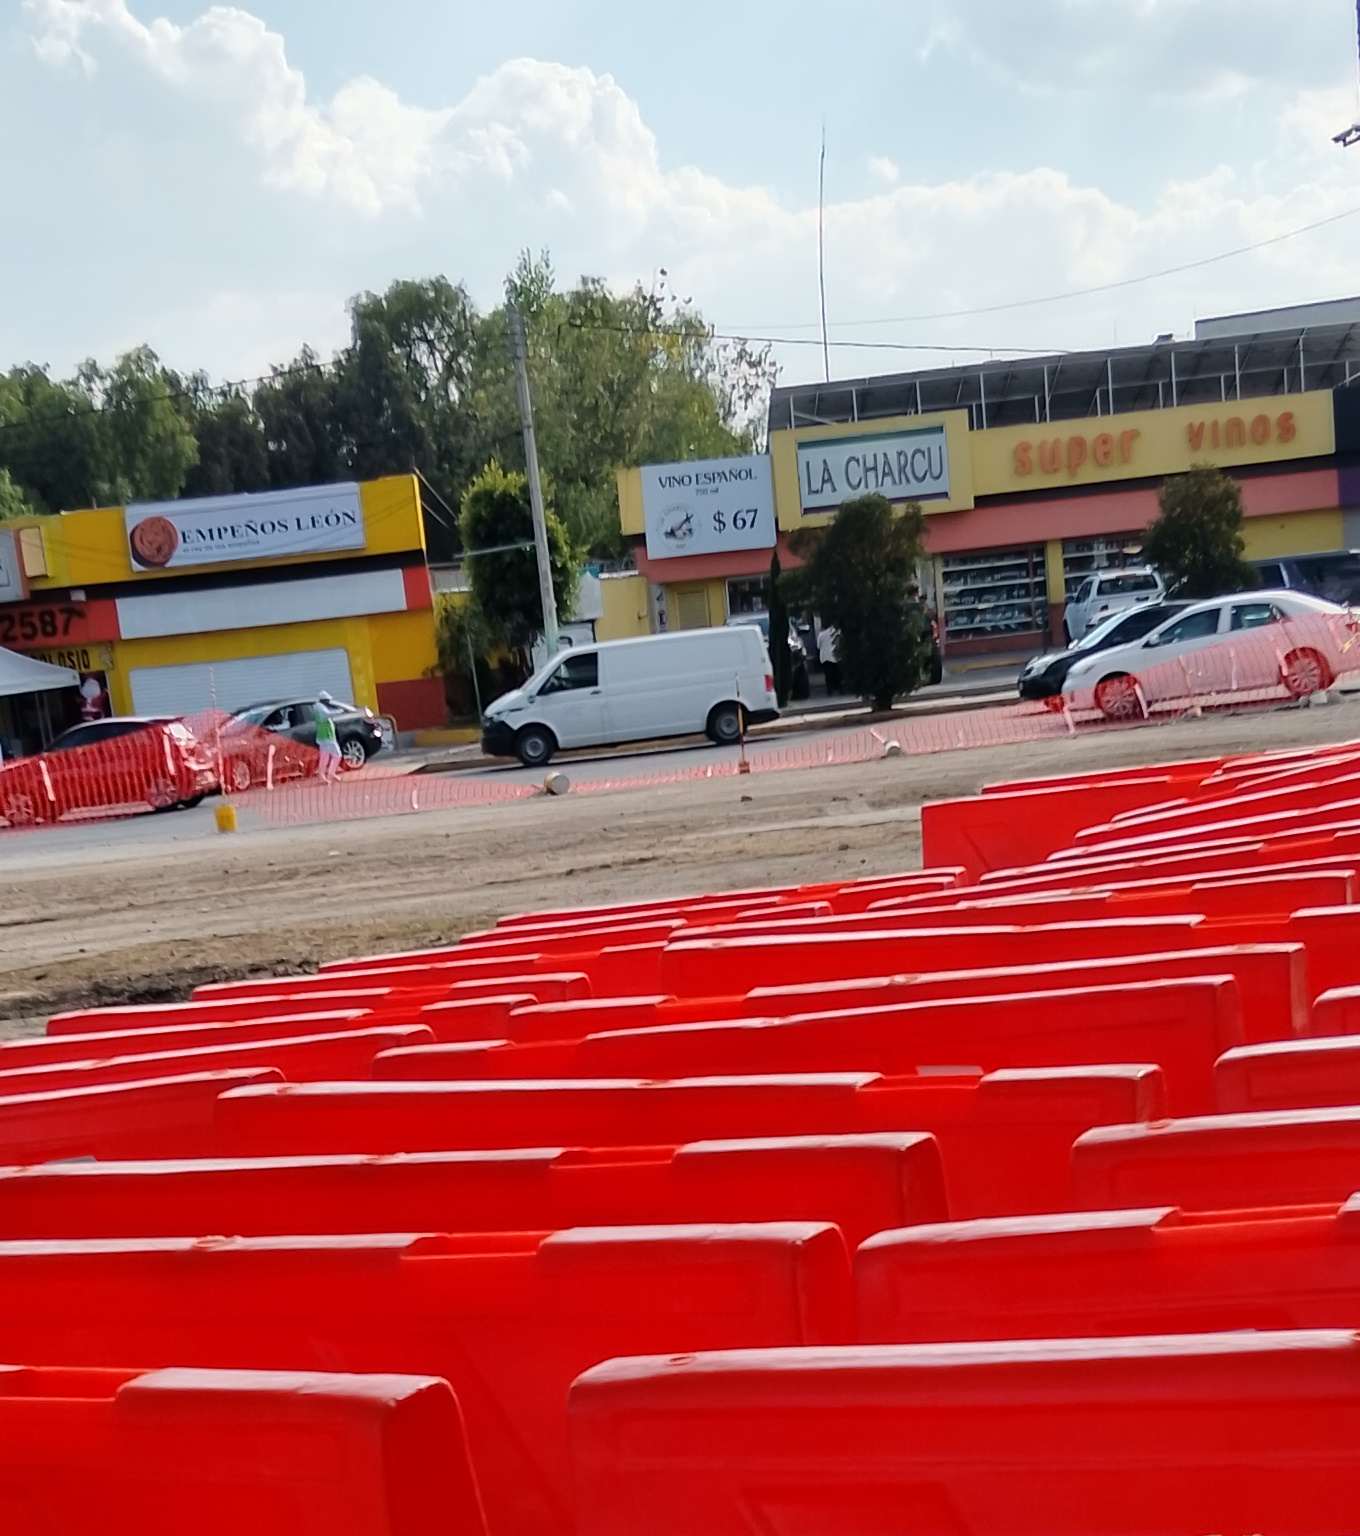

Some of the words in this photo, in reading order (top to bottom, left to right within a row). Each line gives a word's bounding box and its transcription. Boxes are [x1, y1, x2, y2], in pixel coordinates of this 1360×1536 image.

[658, 475, 692, 489] VINO
[695, 468, 757, 486] ESPAÑOL
[806, 459, 836, 495] LA
[845, 445, 943, 491] CHARCU
[181, 519, 289, 544] EMPEÑOS
[296, 509, 358, 532] LEÓN
[713, 510, 726, 534] $
[732, 508, 758, 531] 67
